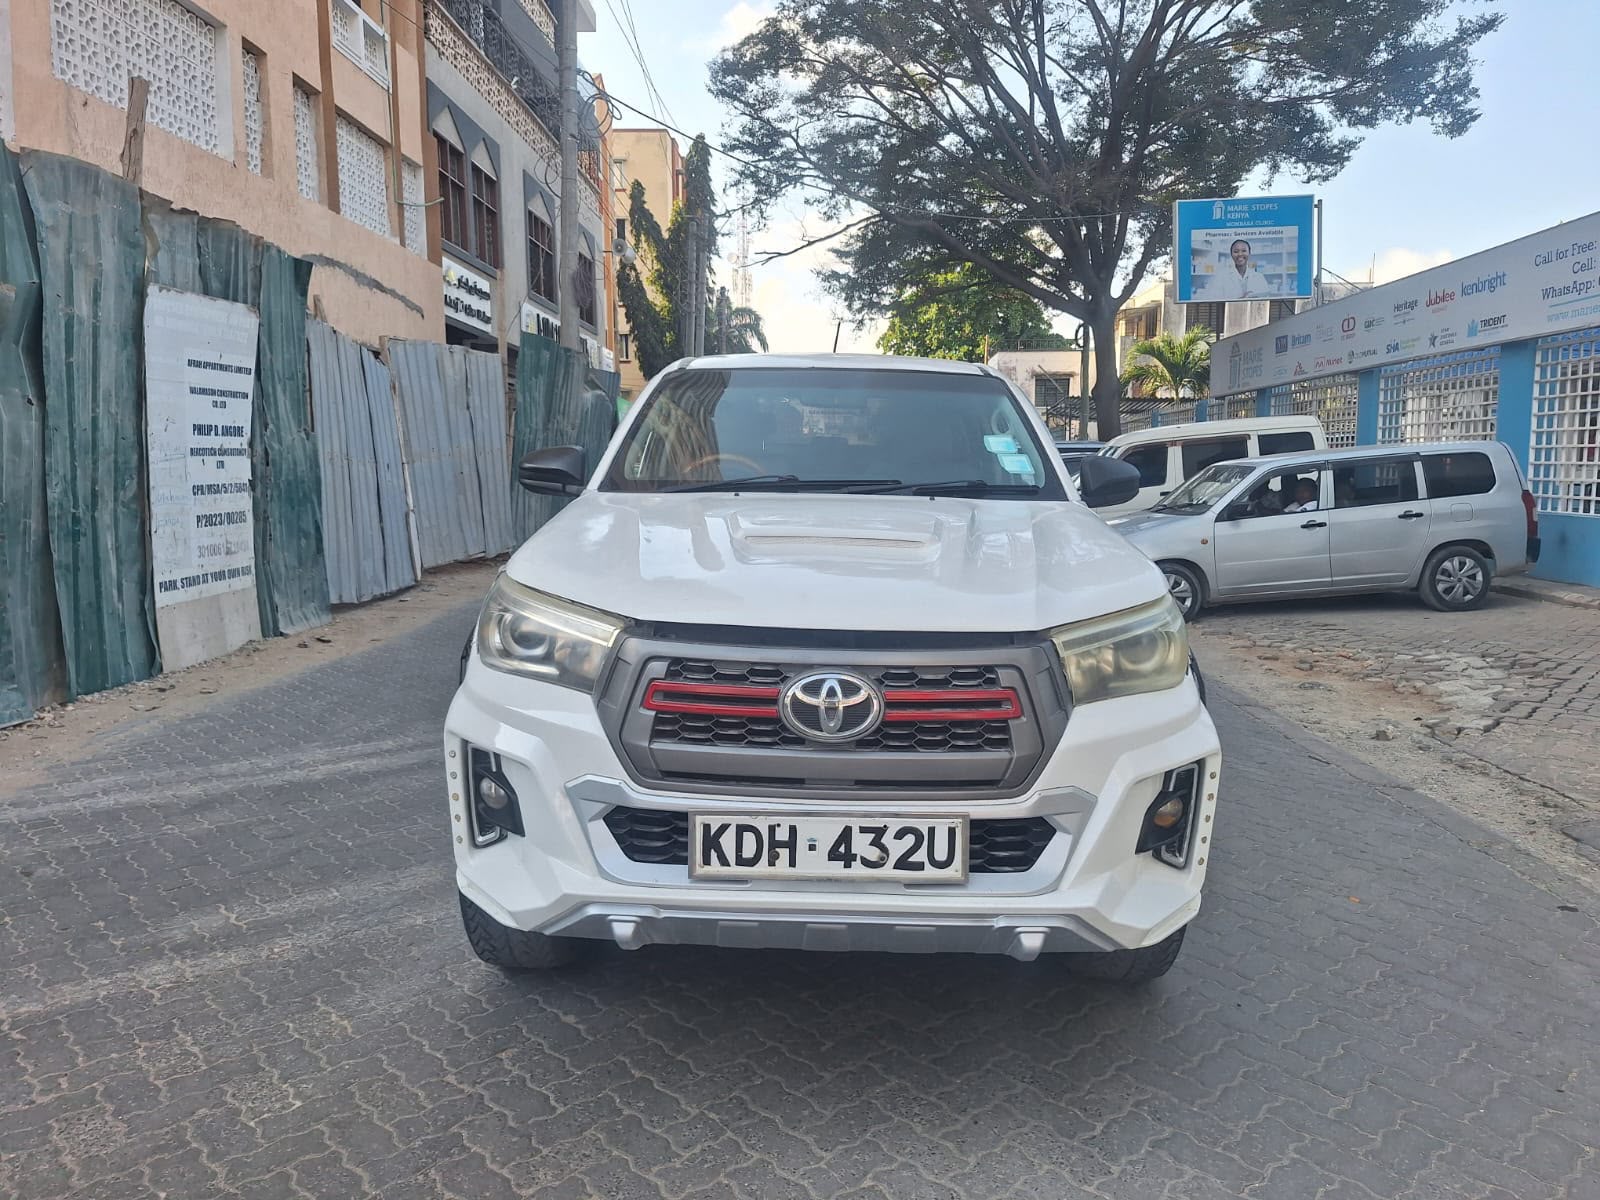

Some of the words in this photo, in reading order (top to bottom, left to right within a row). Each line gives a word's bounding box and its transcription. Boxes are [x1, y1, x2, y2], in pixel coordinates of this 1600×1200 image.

[1252, 202, 1278, 211] STOPES
[1534, 250, 1553, 267] Call
[1555, 248, 1569, 261] for
[1571, 240, 1597, 256] Free:
[1572, 257, 1596, 275] Cell:
[1461, 270, 1507, 297] kenbright
[1541, 279, 1595, 300] WhatsApp:
[1393, 299, 1419, 312] Heritage
[1425, 288, 1455, 307] Jubilee
[1480, 314, 1507, 328] TRIDENT
[1386, 340, 1399, 354] SHA
[192, 424, 213, 436] PHILIP
[214, 425, 221, 436] D.
[180, 574, 201, 589] STAND
[201, 573, 209, 584] AT
[209, 569, 227, 582] YOUR
[226, 567, 241, 580] OWN
[702, 823, 798, 868] KDH
[827, 824, 957, 872] 432U
